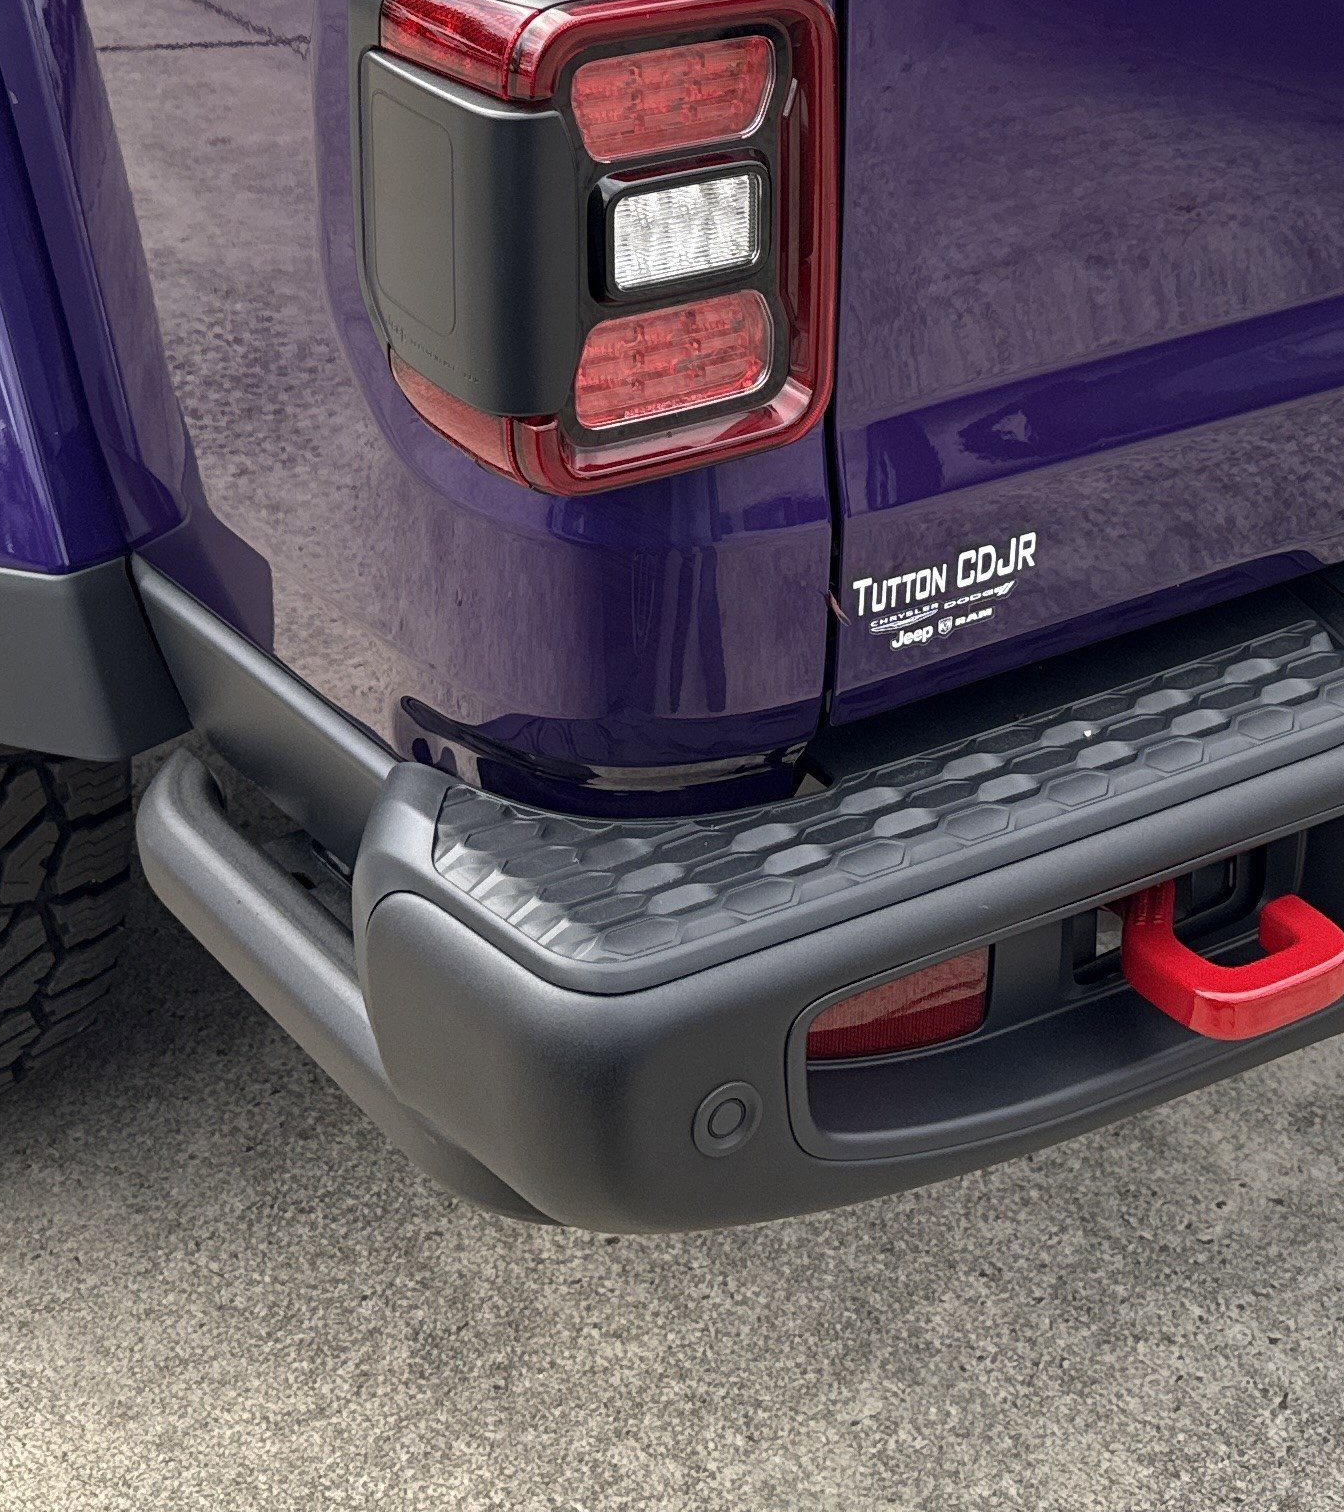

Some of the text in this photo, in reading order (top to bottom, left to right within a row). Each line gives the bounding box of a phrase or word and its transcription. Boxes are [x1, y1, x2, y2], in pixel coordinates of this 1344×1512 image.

[956, 531, 1037, 588] CDJR
[870, 602, 939, 628] CHRYSLER
[890, 607, 993, 649] Jeep RAM
